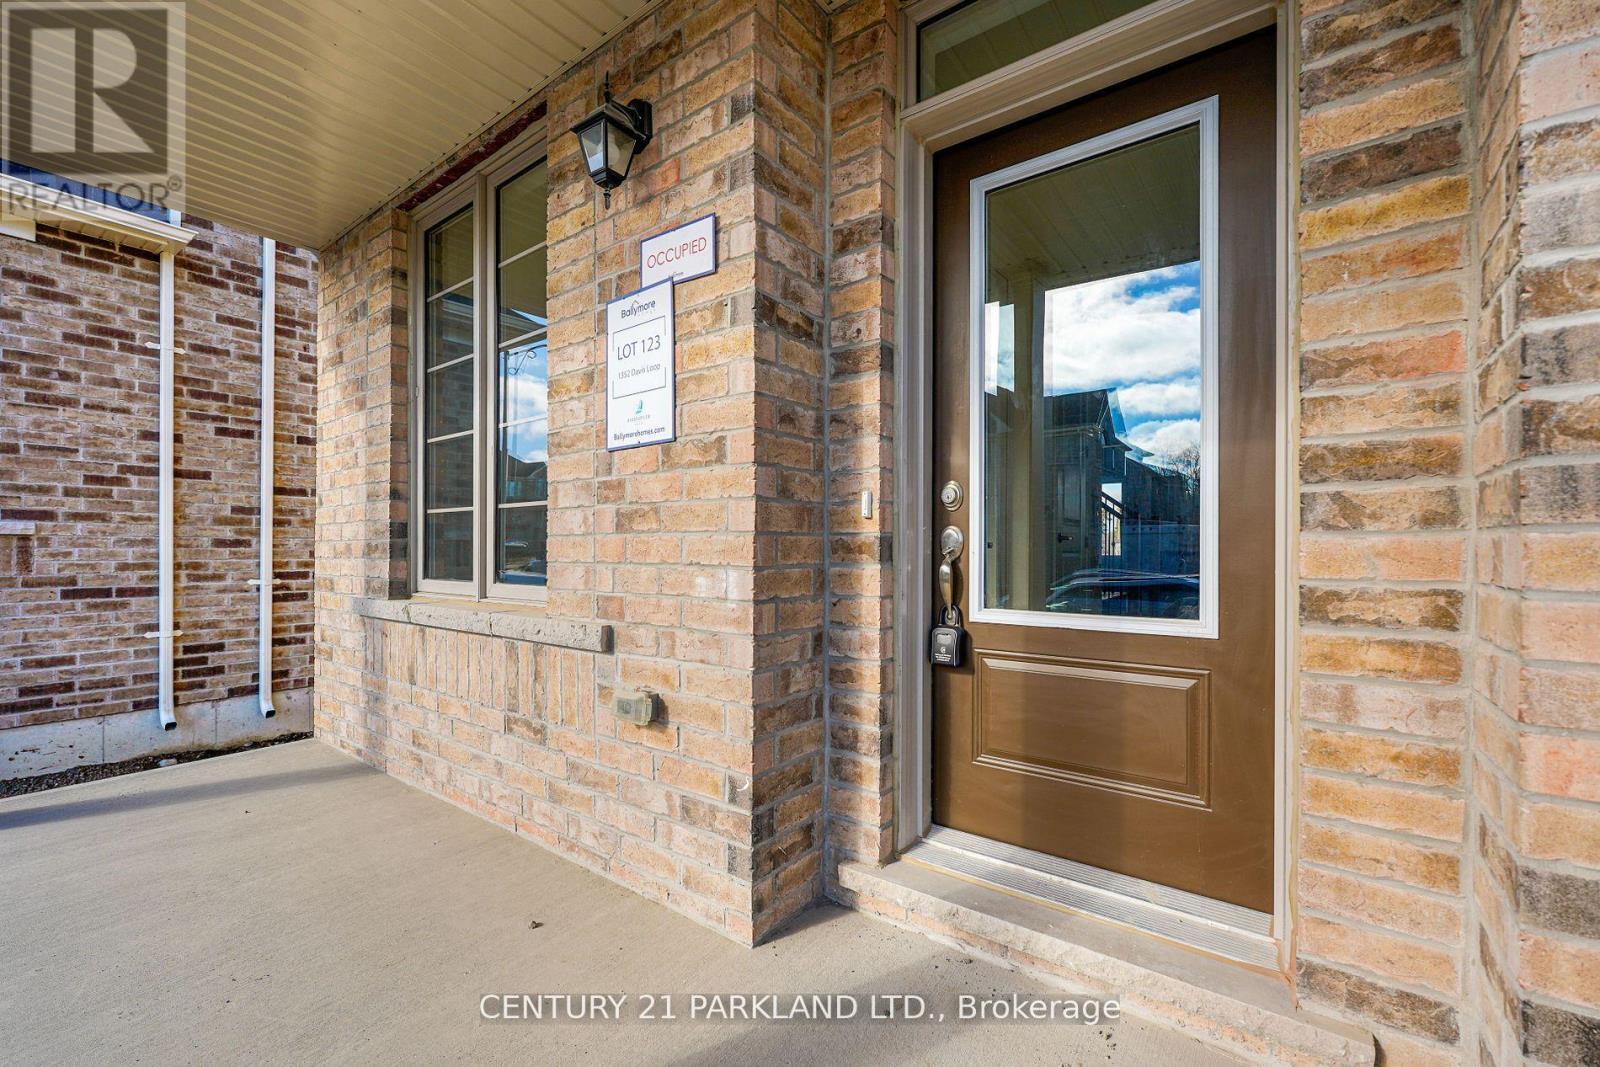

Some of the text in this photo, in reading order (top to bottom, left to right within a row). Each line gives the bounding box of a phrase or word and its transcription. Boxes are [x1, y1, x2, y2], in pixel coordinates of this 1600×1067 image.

[647, 237, 707, 269] OCCUPIED
[621, 300, 656, 319] Ballymore
[617, 334, 661, 361] LOT 123
[647, 363, 661, 373] Loop
[613, 427, 665, 441] Ballymorehomes.com
